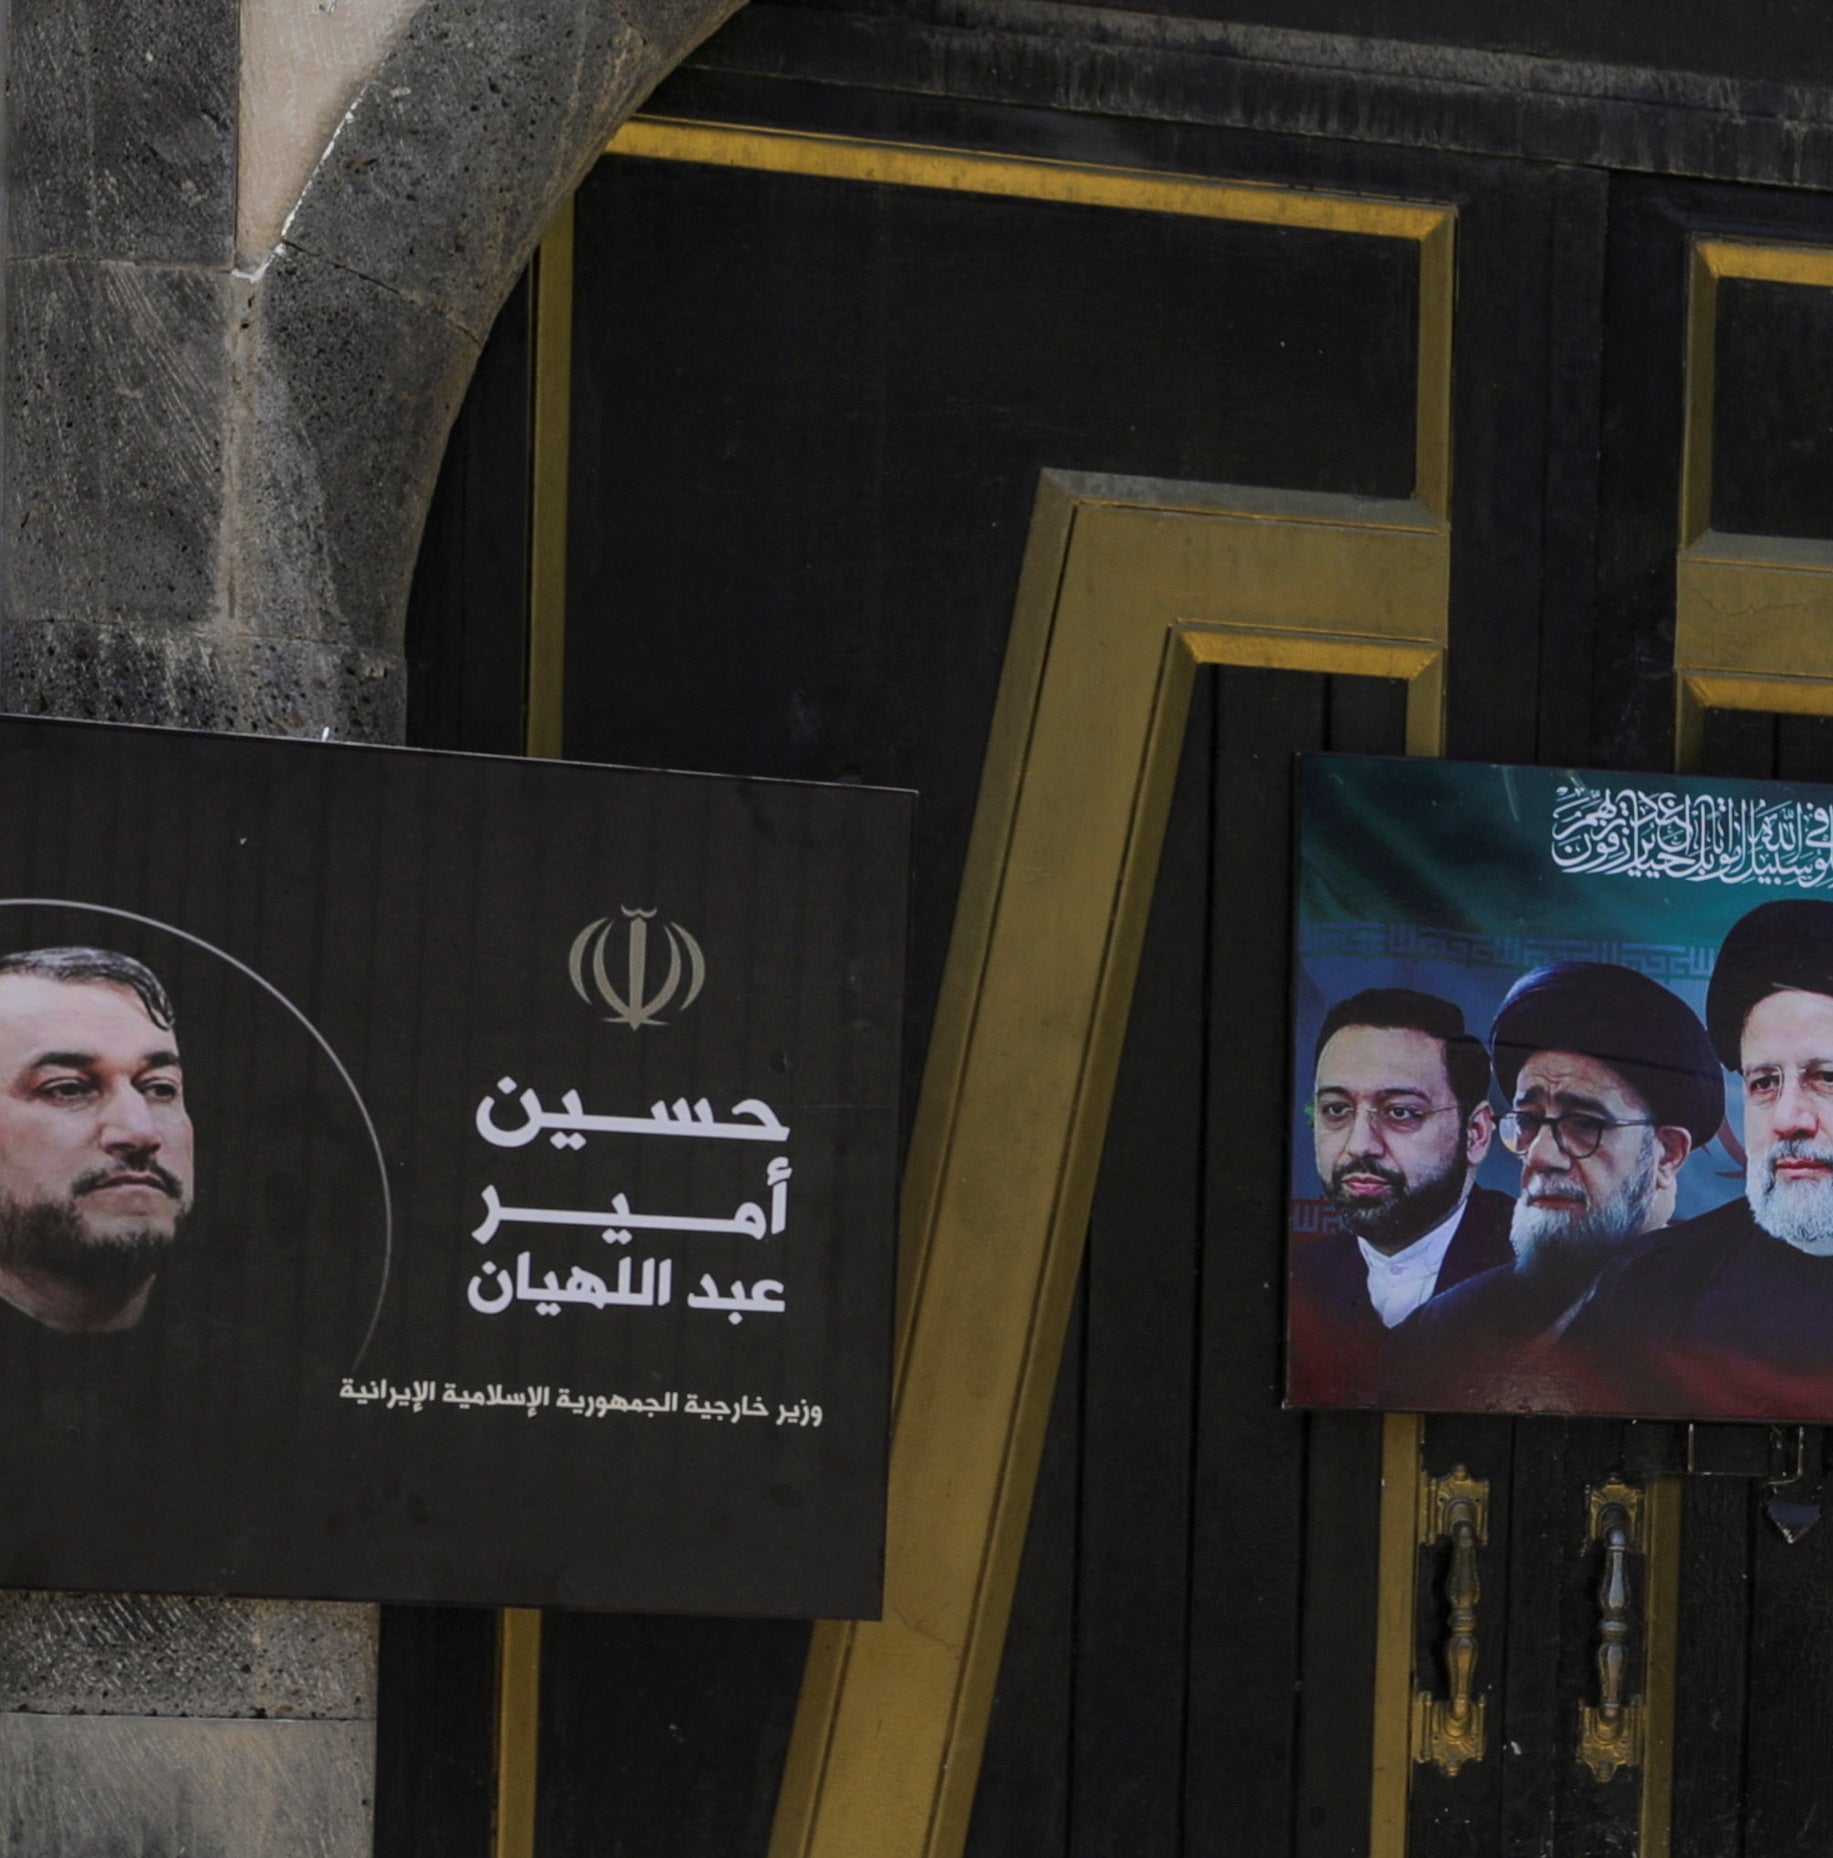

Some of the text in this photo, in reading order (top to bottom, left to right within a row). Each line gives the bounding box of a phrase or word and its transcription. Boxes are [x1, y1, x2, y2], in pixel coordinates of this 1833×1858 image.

[476, 1076, 790, 1150] حسين
[472, 1156, 793, 1245] أمير
[467, 1251, 786, 1325] عبد اللهيان
[339, 1377, 824, 1427] وزير خارجية الجمهورية الإسلامية الإيرانية
